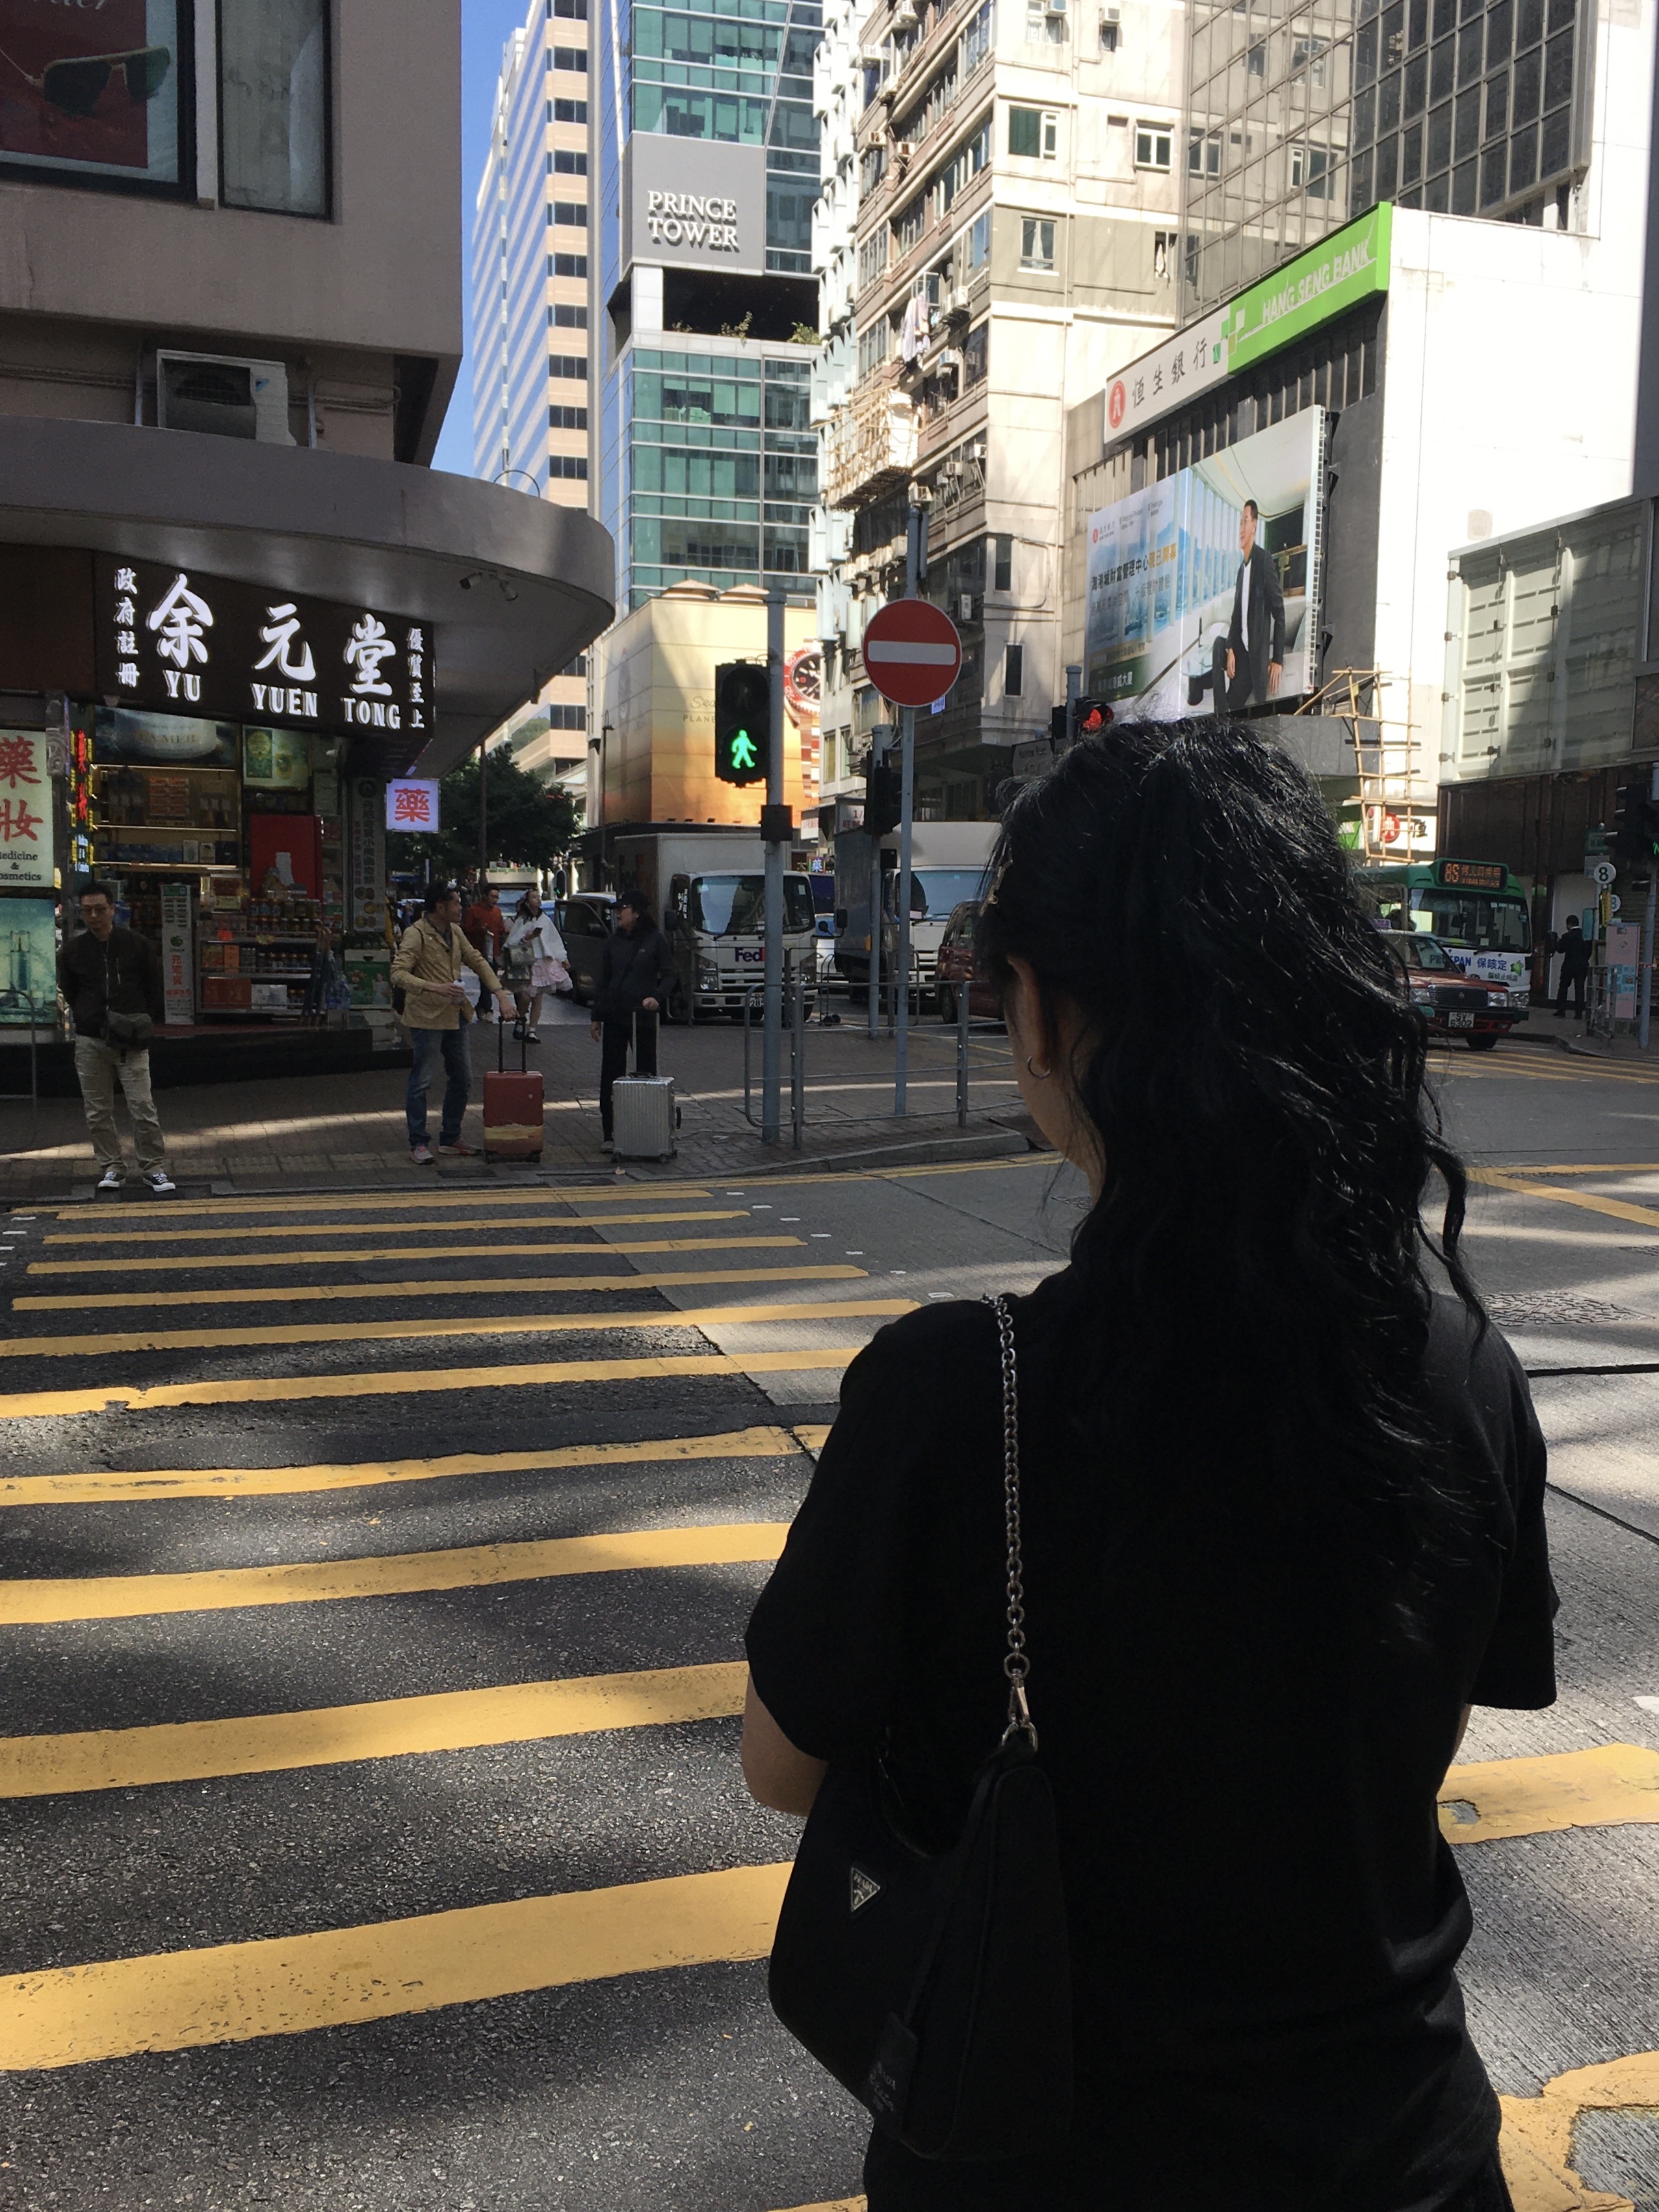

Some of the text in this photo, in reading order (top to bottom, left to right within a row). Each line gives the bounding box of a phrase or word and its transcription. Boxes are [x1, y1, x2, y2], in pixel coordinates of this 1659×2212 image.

[647, 191, 736, 219] PRINCE
[647, 217, 738, 246] TOWER
[1262, 238, 1369, 325] HANG SENG BANK
[1132, 337, 1208, 409] 恒生銀行
[115, 567, 140, 687] 政府註冊
[146, 573, 396, 696] 余元堂
[406, 627, 425, 728] 優質至上
[163, 670, 401, 730] YU YUEN TONG
[690, 696, 716, 709] Sea
[683, 715, 716, 724] PLANE
[395, 788, 430, 823] 藥
[0, 850, 38, 860] edicine
[10, 862, 20, 870] &
[0, 872, 42, 880] osmetics
[1599, 867, 1609, 882] 8
